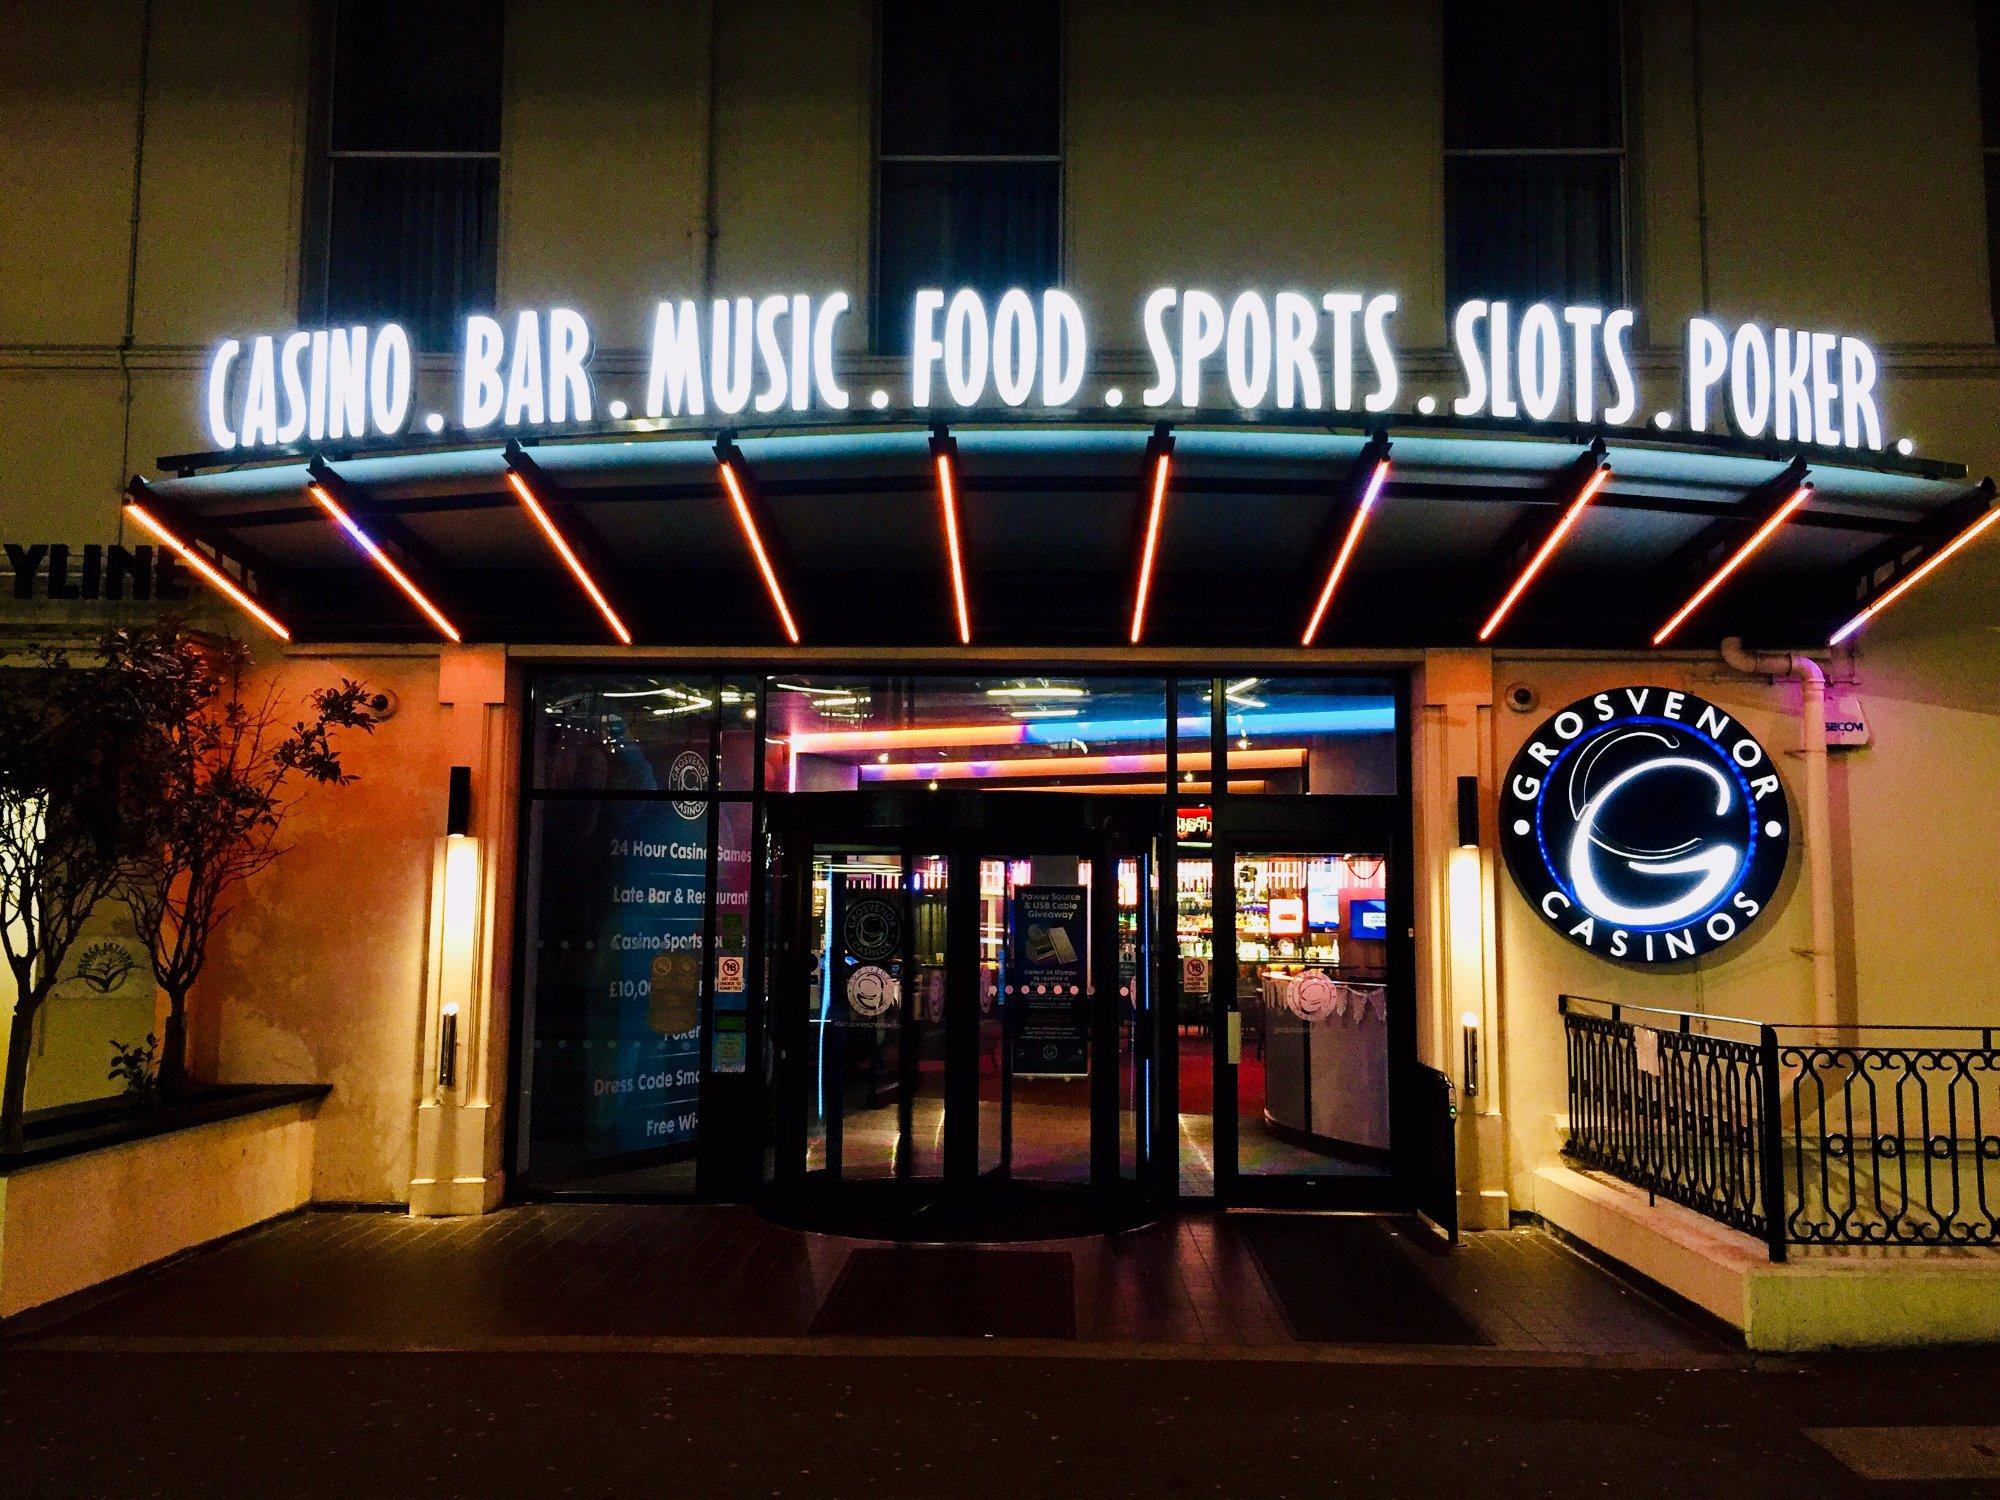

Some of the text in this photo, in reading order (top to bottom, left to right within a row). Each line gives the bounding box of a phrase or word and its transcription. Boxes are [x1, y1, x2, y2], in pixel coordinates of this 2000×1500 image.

[208, 287, 1882, 451] CASINO BAR MUSIC FOOD SPORTS SLOTS POKER
[1825, 722, 1863, 732] SECOM
[1512, 687, 1780, 802] GROSVENOR
[671, 754, 709, 784] GROSVENOR
[611, 838, 628, 856] 24
[632, 840, 667, 858] Hour
[717, 845, 753, 863] Games
[612, 885, 644, 903] Late
[648, 887, 672, 904] Bar
[674, 887, 684, 905] &
[1021, 892, 1080, 901] Power Source
[1024, 901, 1078, 910] & USB Cable
[1027, 910, 1074, 920] Giveaway
[848, 903, 897, 929] GROSVENOR
[1540, 889, 1760, 962] CASINOS
[611, 930, 660, 950] Casino
[726, 962, 737, 972] 18
[592, 1077, 634, 1097] Dress
[637, 1071, 673, 1091] Code
[646, 1118, 676, 1137] Free
